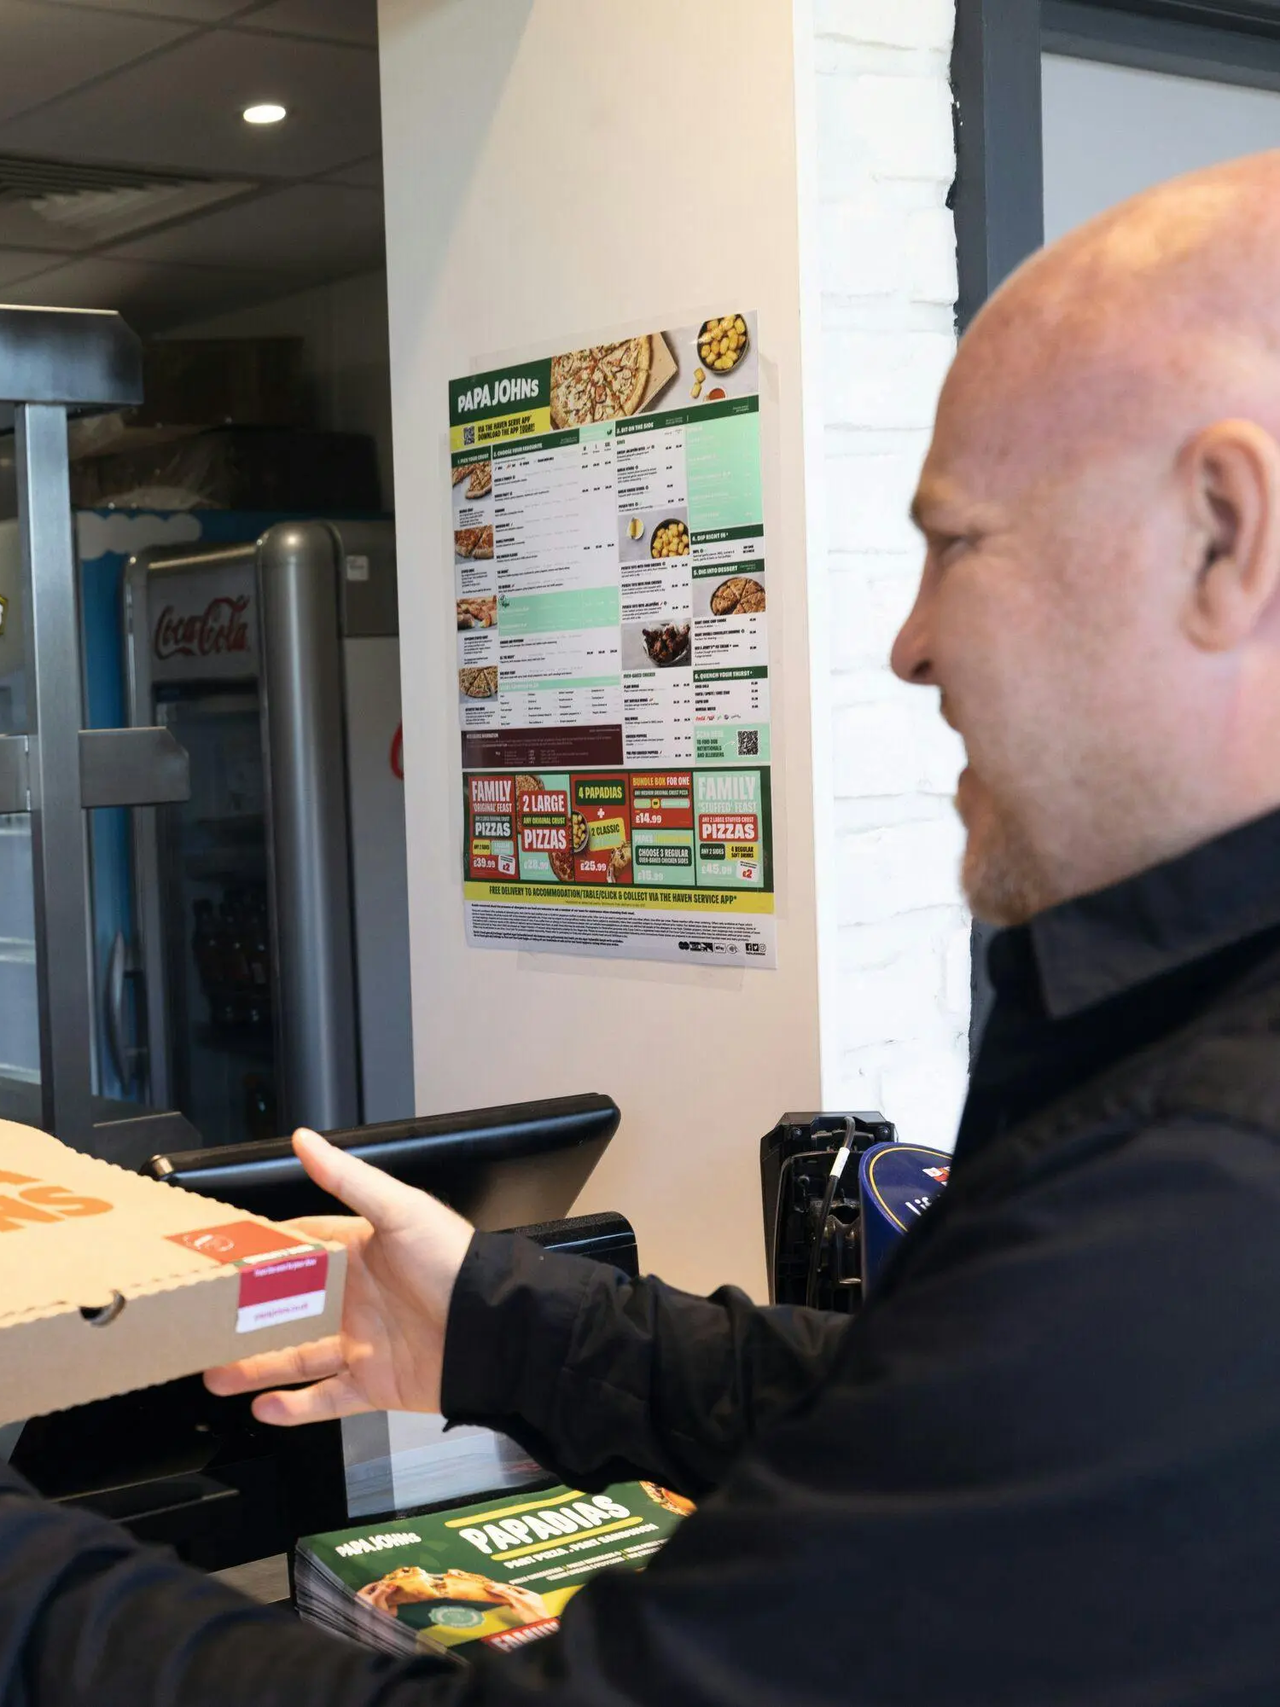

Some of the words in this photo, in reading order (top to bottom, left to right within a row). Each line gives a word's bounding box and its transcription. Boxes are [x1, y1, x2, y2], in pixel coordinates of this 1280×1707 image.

[458, 384, 492, 413] PAPA
[492, 378, 539, 406] JOHNS
[494, 420, 507, 430] HAVEN
[478, 430, 501, 442] DOWNLOAD
[510, 426, 518, 435] APP
[155, 596, 250, 660] Coca-Cola
[633, 777, 654, 786] BUNDLE
[655, 777, 666, 785] BOX
[666, 777, 677, 785] FOR
[678, 777, 690, 785] ONE
[698, 777, 755, 800] FAMILY
[472, 781, 511, 802] FAMILY
[579, 787, 584, 799] 4
[585, 787, 622, 799] PAPADIAS
[497, 803, 512, 812] FEAST
[523, 796, 529, 812] 2
[532, 795, 564, 812] LARGE
[734, 802, 756, 812] FEAST
[635, 813, 662, 823] £14.99
[475, 822, 511, 836] PIZZAS
[591, 828, 595, 836] 2
[596, 824, 620, 836] CLASSIC
[702, 824, 755, 839] PIZZAS
[524, 829, 566, 849] PIZZAS
[639, 849, 660, 857] CHOOSE
[665, 849, 688, 857] REGULAR
[580, 861, 606, 871] £25.99
[489, 886, 500, 894] FREE
[502, 886, 524, 896] DELIVERY
[525, 887, 532, 896] TO
[624, 892, 647, 901] COLLECT
[648, 892, 659, 901] VIA
[660, 893, 671, 902] THE
[672, 894, 692, 903] HAVEN
[694, 894, 719, 904] SERVICE
[458, 1494, 630, 1554] PAPADIAS
[597, 1523, 660, 1544] SANDWICH
[336, 1536, 373, 1558] PAPA
[370, 1532, 422, 1552] JOHNS
